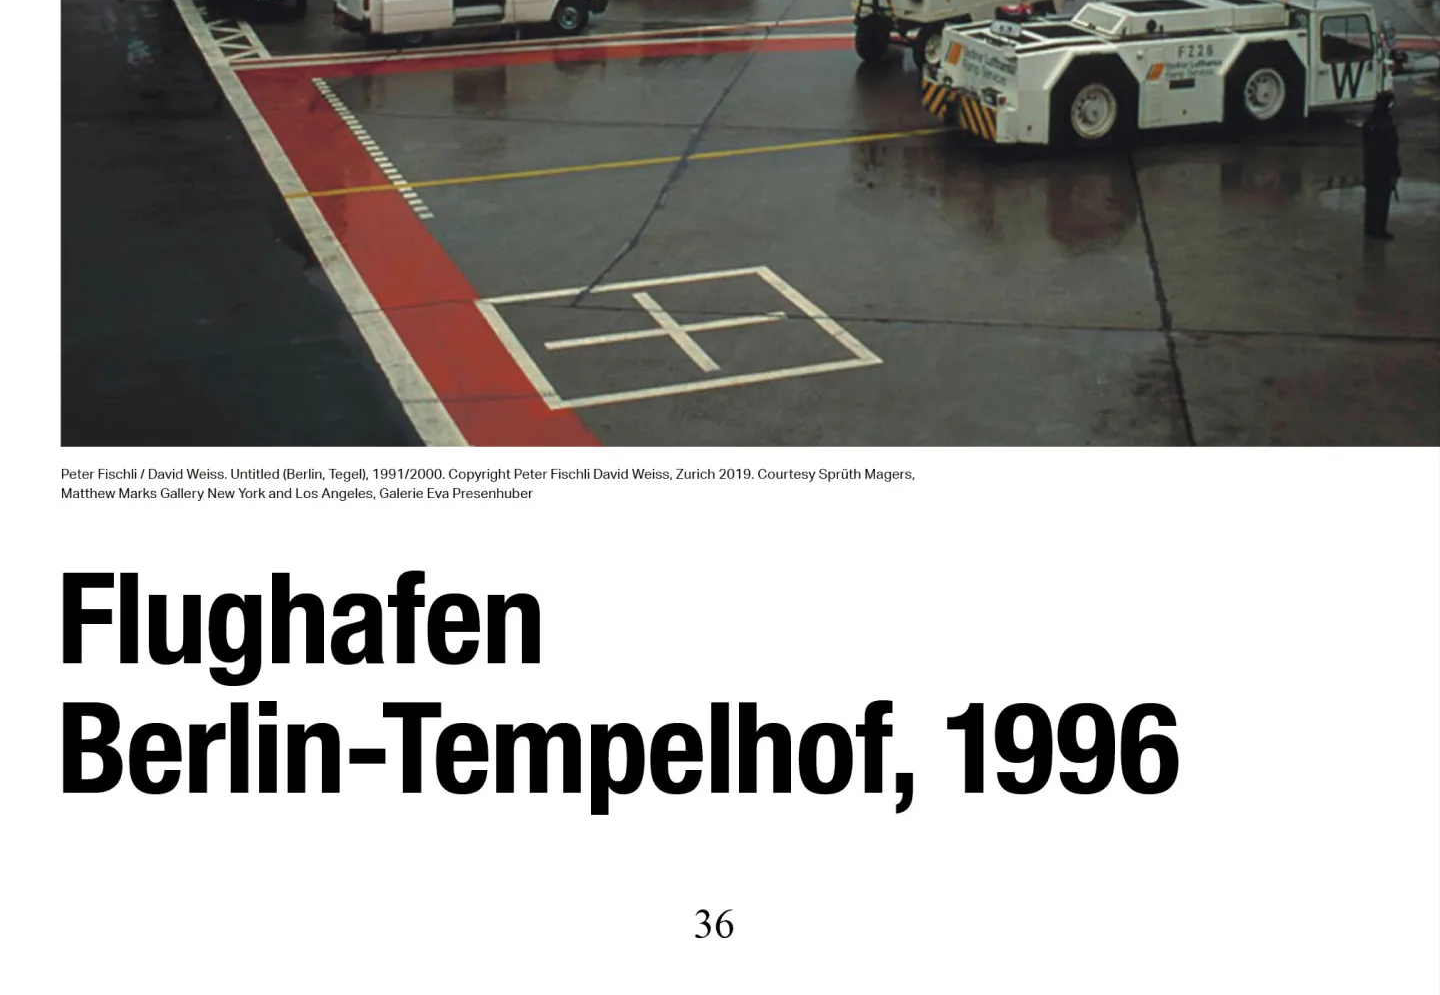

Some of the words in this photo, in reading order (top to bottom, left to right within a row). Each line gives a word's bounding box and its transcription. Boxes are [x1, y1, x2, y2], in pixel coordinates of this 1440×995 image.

[1330, 60, 1366, 100] W
[61, 468, 95, 480] Peter
[98, 468, 137, 480] Fischli
[148, 468, 184, 480] David
[186, 468, 228, 480] Weiss.
[230, 468, 280, 480] Untitled
[282, 468, 326, 481] (Berlin,
[328, 468, 369, 483] Tegel),
[372, 468, 446, 480] 1991/2000.
[448, 468, 512, 483] Copyright
[514, 468, 548, 480] Peter
[550, 468, 590, 480] Fischli
[593, 468, 629, 480] David
[631, 468, 673, 481] Weiss,
[675, 468, 716, 480] Zurich
[718, 468, 755, 480] 2019.
[757, 468, 816, 483] Courtesy
[818, 468, 862, 483] Sprüth
[864, 468, 915, 483] Magers,
[61, 487, 116, 499] Matthew
[118, 487, 158, 499] Marks
[160, 487, 205, 502] Gallery
[207, 487, 236, 499] New
[237, 487, 266, 499] York
[268, 487, 292, 499] and
[295, 487, 319, 499] Los
[321, 487, 377, 502] Angeles,
[379, 487, 424, 499] Galerie
[427, 487, 450, 499] Eva
[452, 487, 534, 499] Presenhuber
[62, 569, 541, 687] Flughafen
[62, 699, 914, 816] Berlin-Tempelhof,
[946, 702, 1180, 795] 1996
[694, 908, 734, 939] 36
